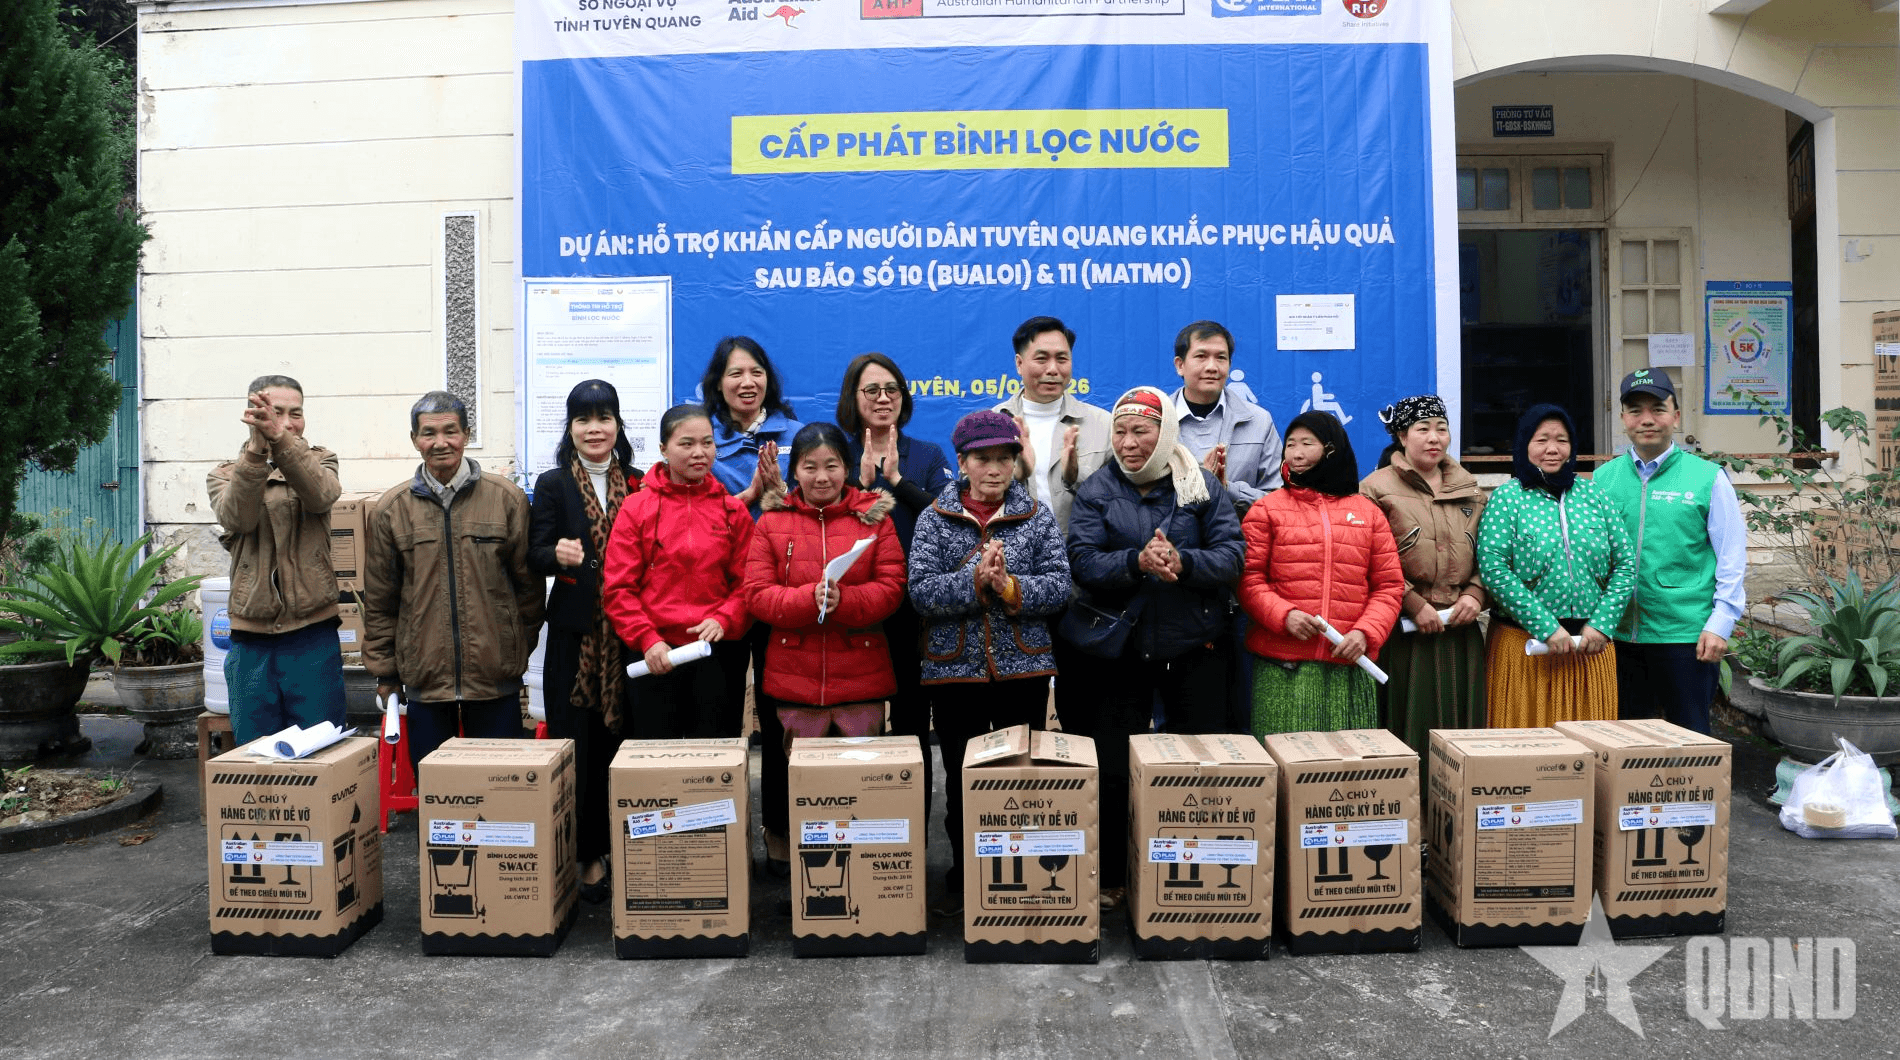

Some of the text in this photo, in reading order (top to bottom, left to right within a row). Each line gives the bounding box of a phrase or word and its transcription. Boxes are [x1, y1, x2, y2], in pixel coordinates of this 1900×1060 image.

[1352, 3, 1378, 14] RIC
[728, 7, 758, 21] Aid
[554, 15, 701, 32] TỈNH TUYÊN QUANG
[759, 119, 1199, 162] CẤP PHÁT BÌNH LỌC NƯỚC
[559, 213, 1395, 263] DỰ ÁN: HỖ TRỢ KHẨN CẤP NGƯỜI DÂN TUYÊN QUANG KHẮC PHỤC HẬU QUẢ
[755, 255, 1192, 291] SAU BÃO SỐ 10 (BUALOI) & 11 (MATMO)
[1739, 342, 1754, 352] 5K
[1630, 377, 1654, 387] OXFAM
[1536, 762, 1559, 772] unicef
[488, 774, 511, 783] unicef
[682, 775, 705, 784] unicef
[861, 773, 885, 782] unicef
[1471, 786, 1531, 796] SWACF
[424, 795, 484, 805] SWACF
[796, 796, 857, 807] SWACF
[1627, 789, 1653, 804] HÀNG
[617, 798, 678, 808] SWACF
[220, 804, 246, 820] HÀNG
[1158, 807, 1185, 823] HÀNG
[1305, 804, 1332, 819] HÀNG
[979, 811, 1007, 827] HÀNG
[1641, 870, 1657, 879] THEO
[240, 889, 257, 897] THEO
[1325, 886, 1343, 896] THEO
[998, 896, 1017, 905] THEO
[1175, 892, 1192, 901] THEO
